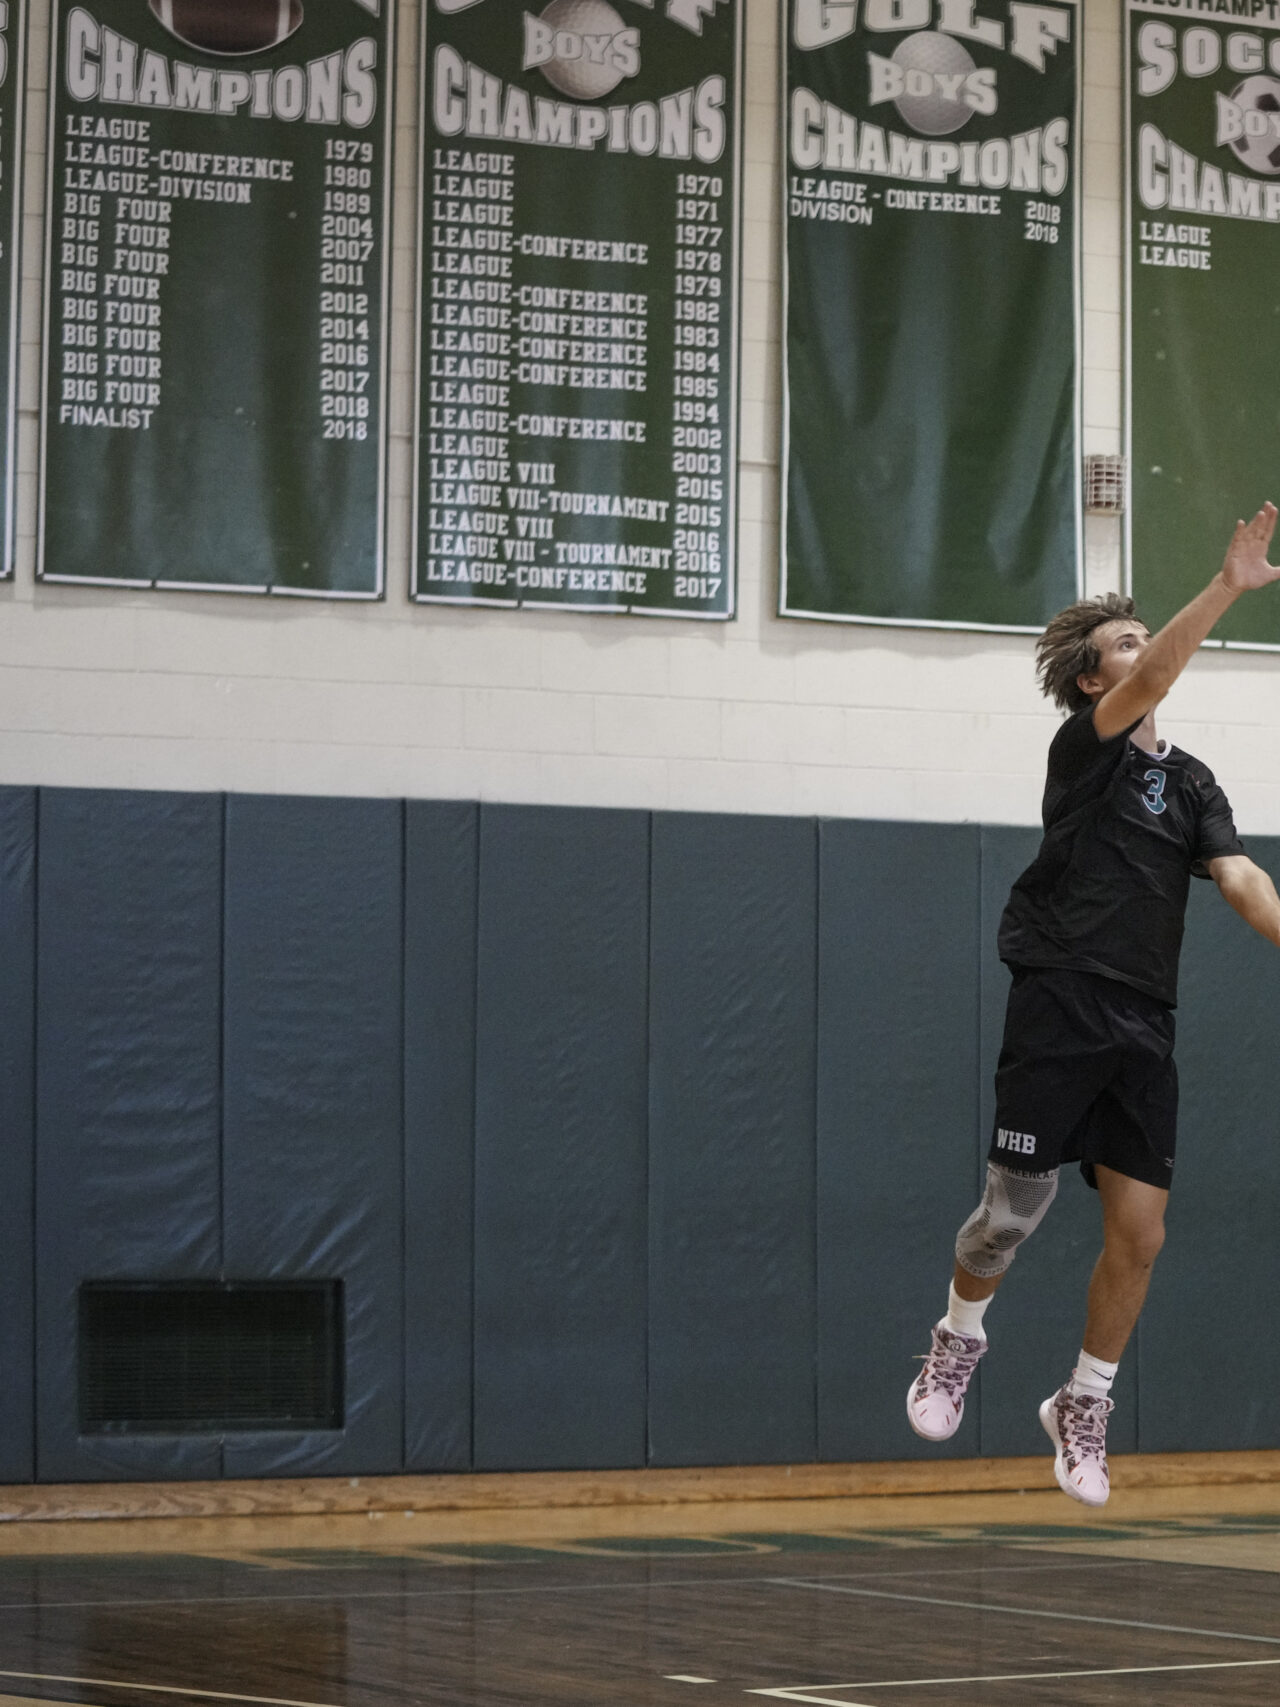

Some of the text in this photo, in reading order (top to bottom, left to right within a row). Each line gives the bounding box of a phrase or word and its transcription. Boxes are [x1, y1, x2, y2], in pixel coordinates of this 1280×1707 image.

[523, 10, 642, 78] BOYS
[67, 7, 377, 129] CHAMPIONS
[867, 51, 998, 116] BOYS
[434, 43, 726, 163] CHAMPIONS
[66, 115, 372, 162] LEAGUE 1979
[791, 86, 1069, 196] CHAMPIONS
[66, 141, 370, 188] LEAGUE-CONFERENCE 1980
[434, 149, 722, 197] LEAGUE 1970
[65, 168, 370, 214] LEAGUE-DIVISION 1989
[677, 200, 717, 222] 1971
[792, 177, 866, 202] LEAGUE
[886, 189, 1000, 214] CONFERENCE
[1026, 201, 1060, 223] 2018
[64, 193, 372, 238] BIG FOUR 2004
[434, 200, 722, 246] LEAGUE 1977
[792, 198, 1058, 243] DIVISION 2018
[1140, 222, 1210, 246] LEAGUE
[62, 218, 374, 261] BIG FOUR 2007
[433, 226, 721, 272] LEAGUE-CONFERENCE 1978
[1140, 245, 1211, 270] LEAGUE
[62, 243, 363, 285] BIG FOUR 2011
[62, 270, 368, 314] BIG FOUR 2012
[432, 278, 719, 322] LEAGUE-CONFERENCE 1982
[676, 275, 720, 297] 1979
[63, 298, 368, 340] BIG FOUR 2014
[675, 326, 718, 347] 1983
[63, 324, 368, 366] BIG FOUR 2016
[675, 351, 719, 372] 1984
[63, 352, 369, 392] BIG FOUR 2017
[674, 376, 718, 398] 1985
[62, 379, 368, 418] BIG FOUR 2018
[431, 382, 718, 423] LEAGUE 1994
[60, 404, 367, 440] FINALIST 2018
[430, 408, 721, 448] LEAGUE-CONFERENCE 2002
[430, 434, 721, 474] LEAGUE 2003
[431, 458, 722, 500] LEAGUE VIII 2015
[430, 483, 721, 526] LEAGUE VIII-TOURNAMENT 2015
[430, 508, 718, 552] LEAGUE VIII 2016
[430, 533, 498, 558] LEAGUE
[504, 540, 534, 561] VIII
[556, 542, 672, 569] TOURNAMENT
[676, 550, 720, 572] 2016
[428, 560, 721, 598] LEAGUE-CONFERENCE 2017
[1141, 769, 1167, 815] 3
[997, 1128, 1037, 1155] WHB
